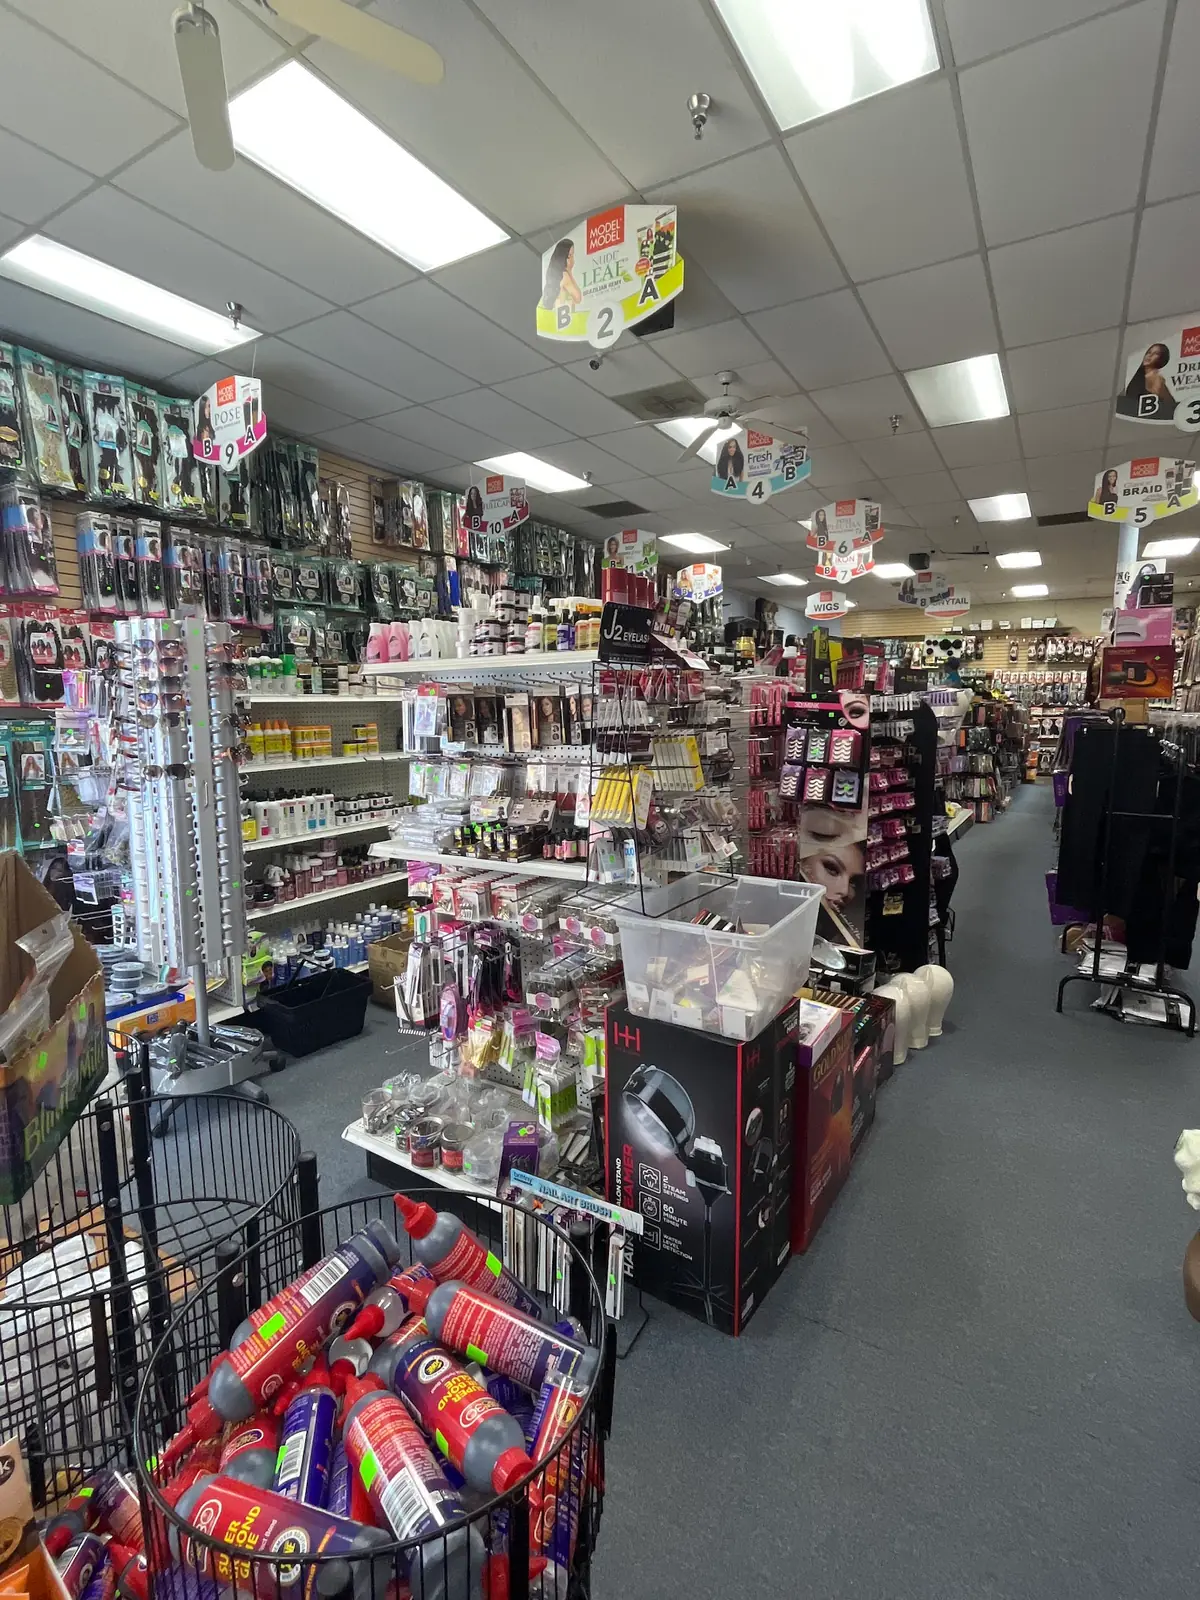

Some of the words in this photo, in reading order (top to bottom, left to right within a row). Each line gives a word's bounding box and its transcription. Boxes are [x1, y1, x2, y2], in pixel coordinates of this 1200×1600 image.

[589, 219, 621, 239] MODEL
[589, 231, 621, 250] MODEL
[582, 261, 624, 288] LEAF
[638, 277, 660, 305] A
[557, 308, 571, 330] B
[597, 307, 614, 340] 2
[1141, 396, 1157, 414] B
[1186, 400, 1200, 424] 3
[214, 407, 241, 425] POSE
[245, 427, 255, 443] A
[204, 440, 211, 455] B
[225, 443, 234, 464] 9
[747, 450, 773, 463] Fresh
[785, 466, 796, 480] B
[725, 476, 736, 490] A
[1123, 484, 1162, 496] BRAID
[752, 482, 764, 499] 4
[1167, 495, 1181, 508] A
[511, 510, 518, 521] A
[1105, 503, 1115, 515] B
[1134, 507, 1147, 523] 5
[473, 517, 479, 527] B
[489, 522, 501, 534] 10
[819, 537, 825, 546] B
[862, 532, 870, 541] A
[839, 541, 847, 553] 6
[643, 557, 649, 565] A
[841, 571, 847, 580] 7
[813, 603, 840, 611] WIGS
[931, 598, 968, 606] NYTAIL
[623, 632, 650, 643] EYELAS
[623, 1143, 634, 1209] EAMER
[663, 1175, 668, 1183] 2
[663, 1183, 686, 1197] STEAM
[663, 1188, 689, 1203] SETTINGS
[539, 1183, 560, 1198] NAIL
[579, 1197, 612, 1218] BRUSH
[663, 1203, 674, 1214] 60
[663, 1212, 688, 1226] MINUTE
[663, 1234, 682, 1245] WATER
[663, 1239, 679, 1250] LEVEL
[623, 1232, 634, 1277] HAIR
[663, 1244, 693, 1261] DETECTION
[437, 1382, 467, 1411] BOND
